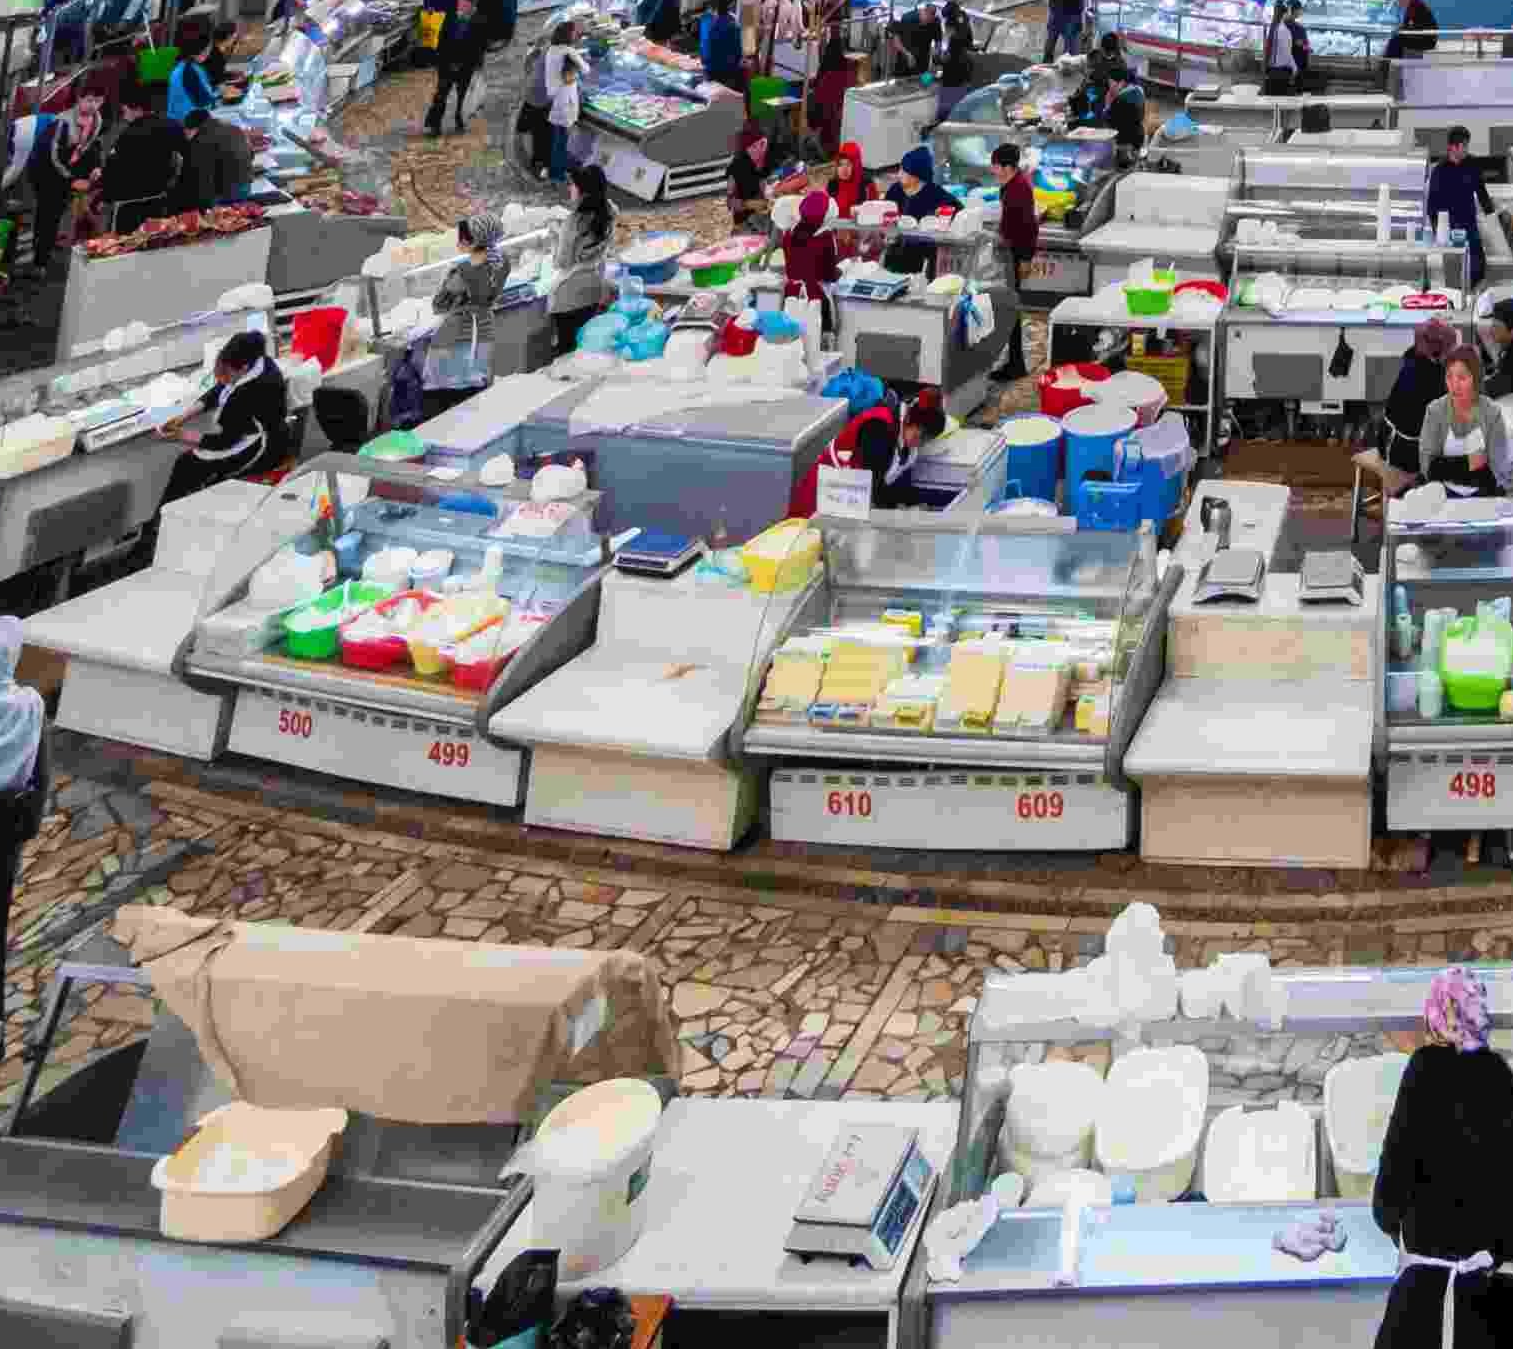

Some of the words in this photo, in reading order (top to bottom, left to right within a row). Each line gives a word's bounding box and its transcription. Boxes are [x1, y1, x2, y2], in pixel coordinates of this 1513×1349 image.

[278, 709, 313, 738] 500
[428, 741, 471, 767] 499
[1449, 769, 1497, 799] 498
[827, 790, 873, 818] 610
[1016, 791, 1065, 821] 609
